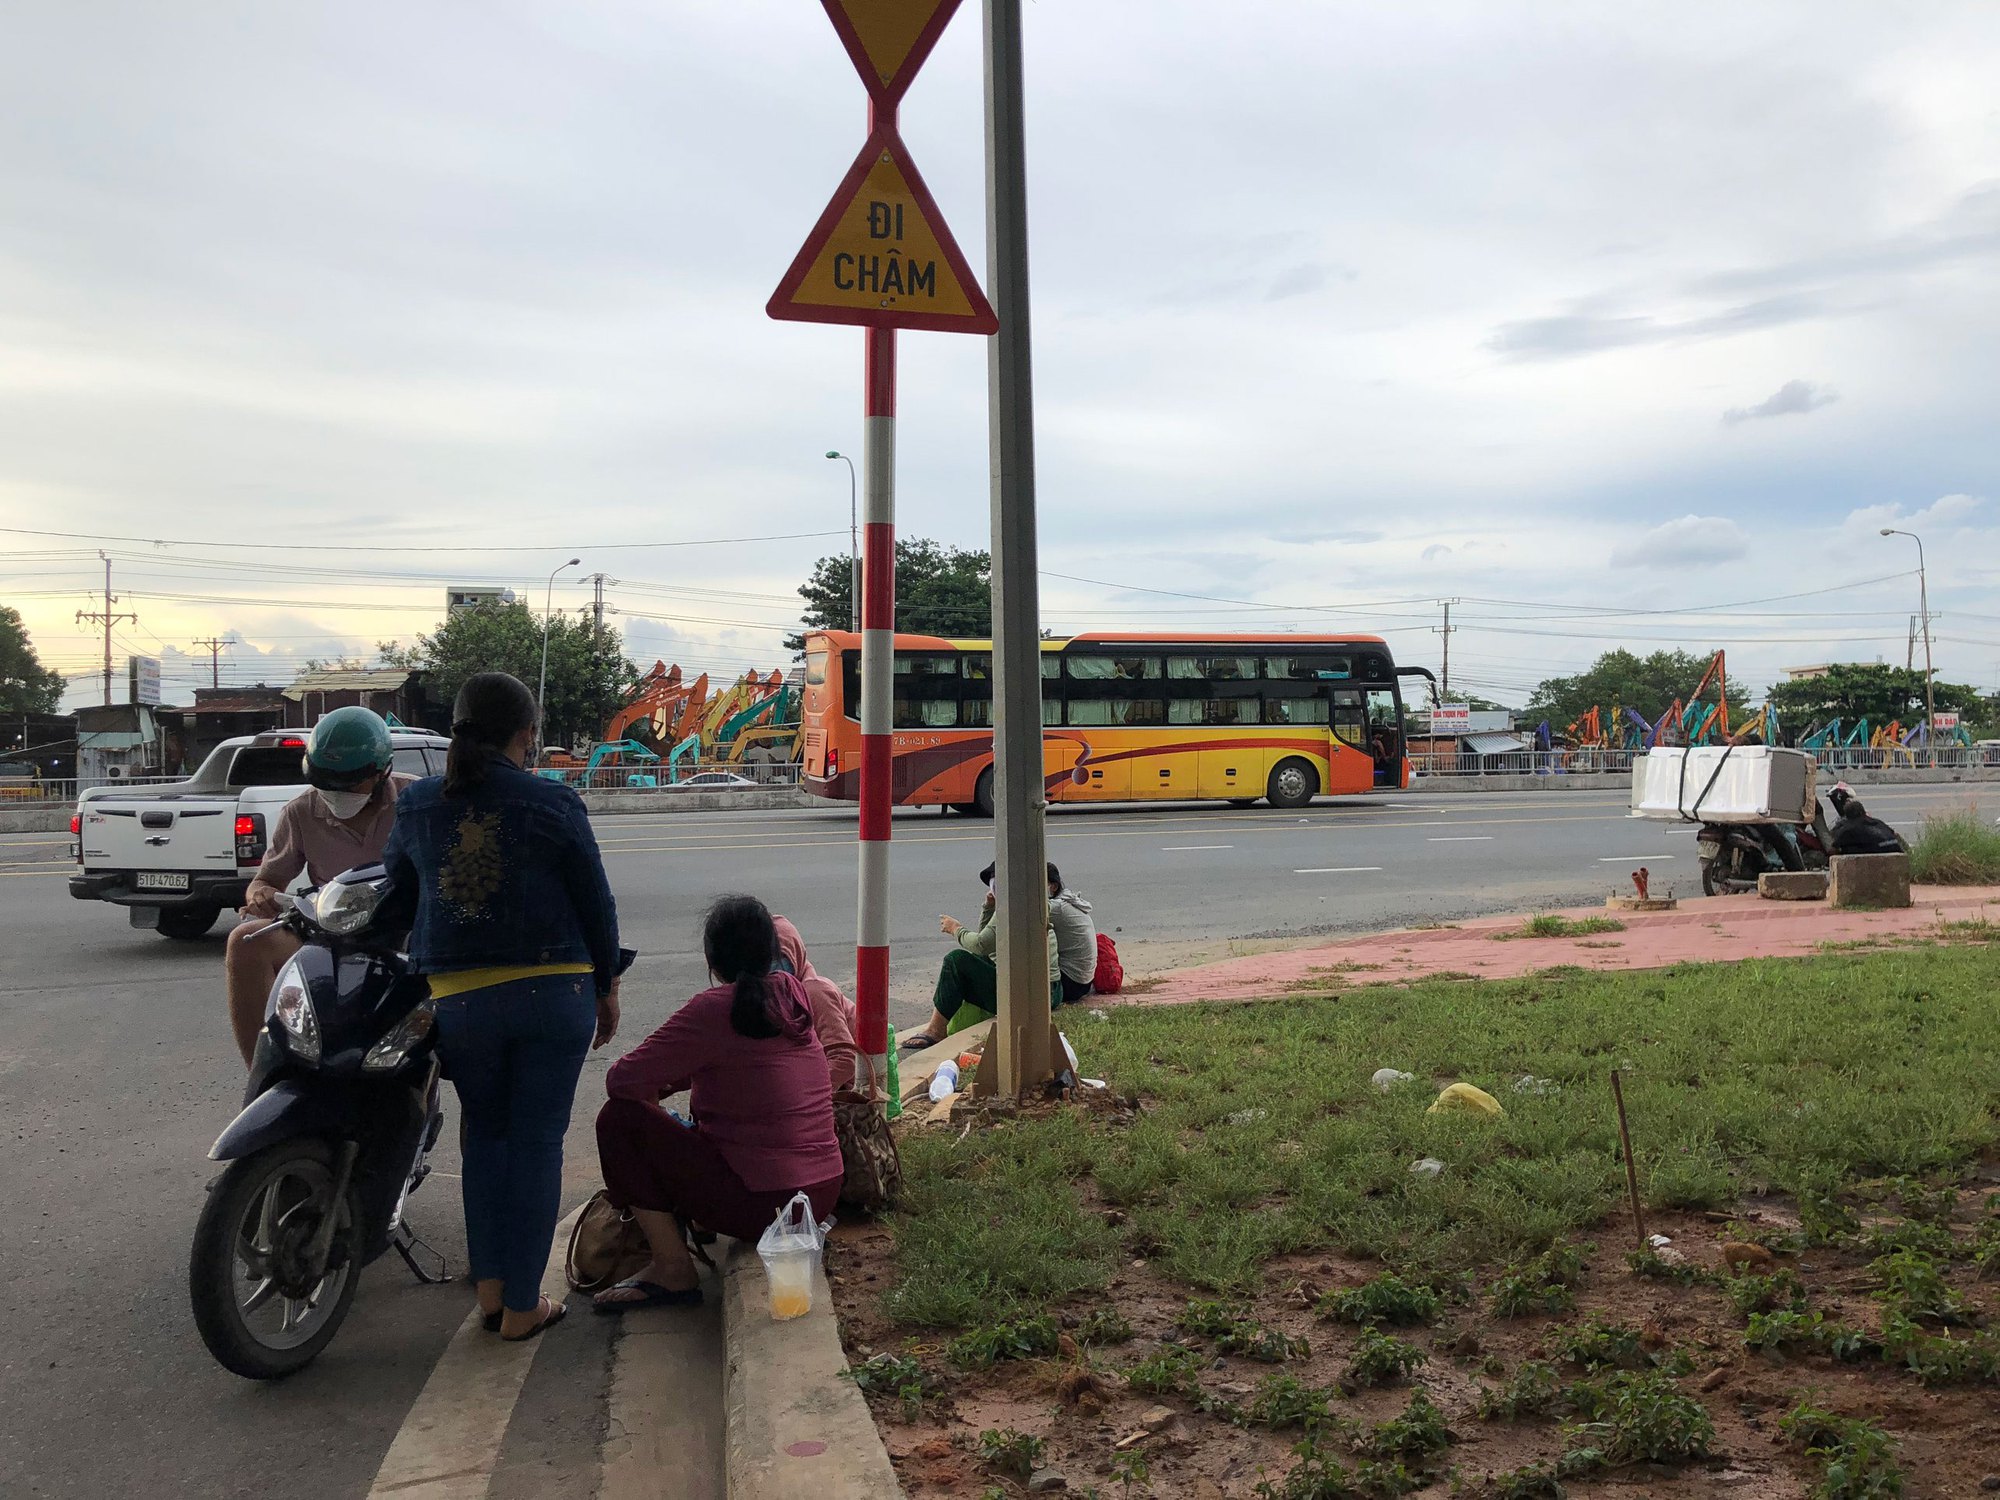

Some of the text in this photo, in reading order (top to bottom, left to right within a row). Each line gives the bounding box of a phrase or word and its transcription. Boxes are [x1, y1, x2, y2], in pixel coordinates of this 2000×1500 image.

[867, 201, 903, 241] ĐI
[833, 248, 936, 303] CHẬM
[138, 873, 187, 887] 51D-470.62
